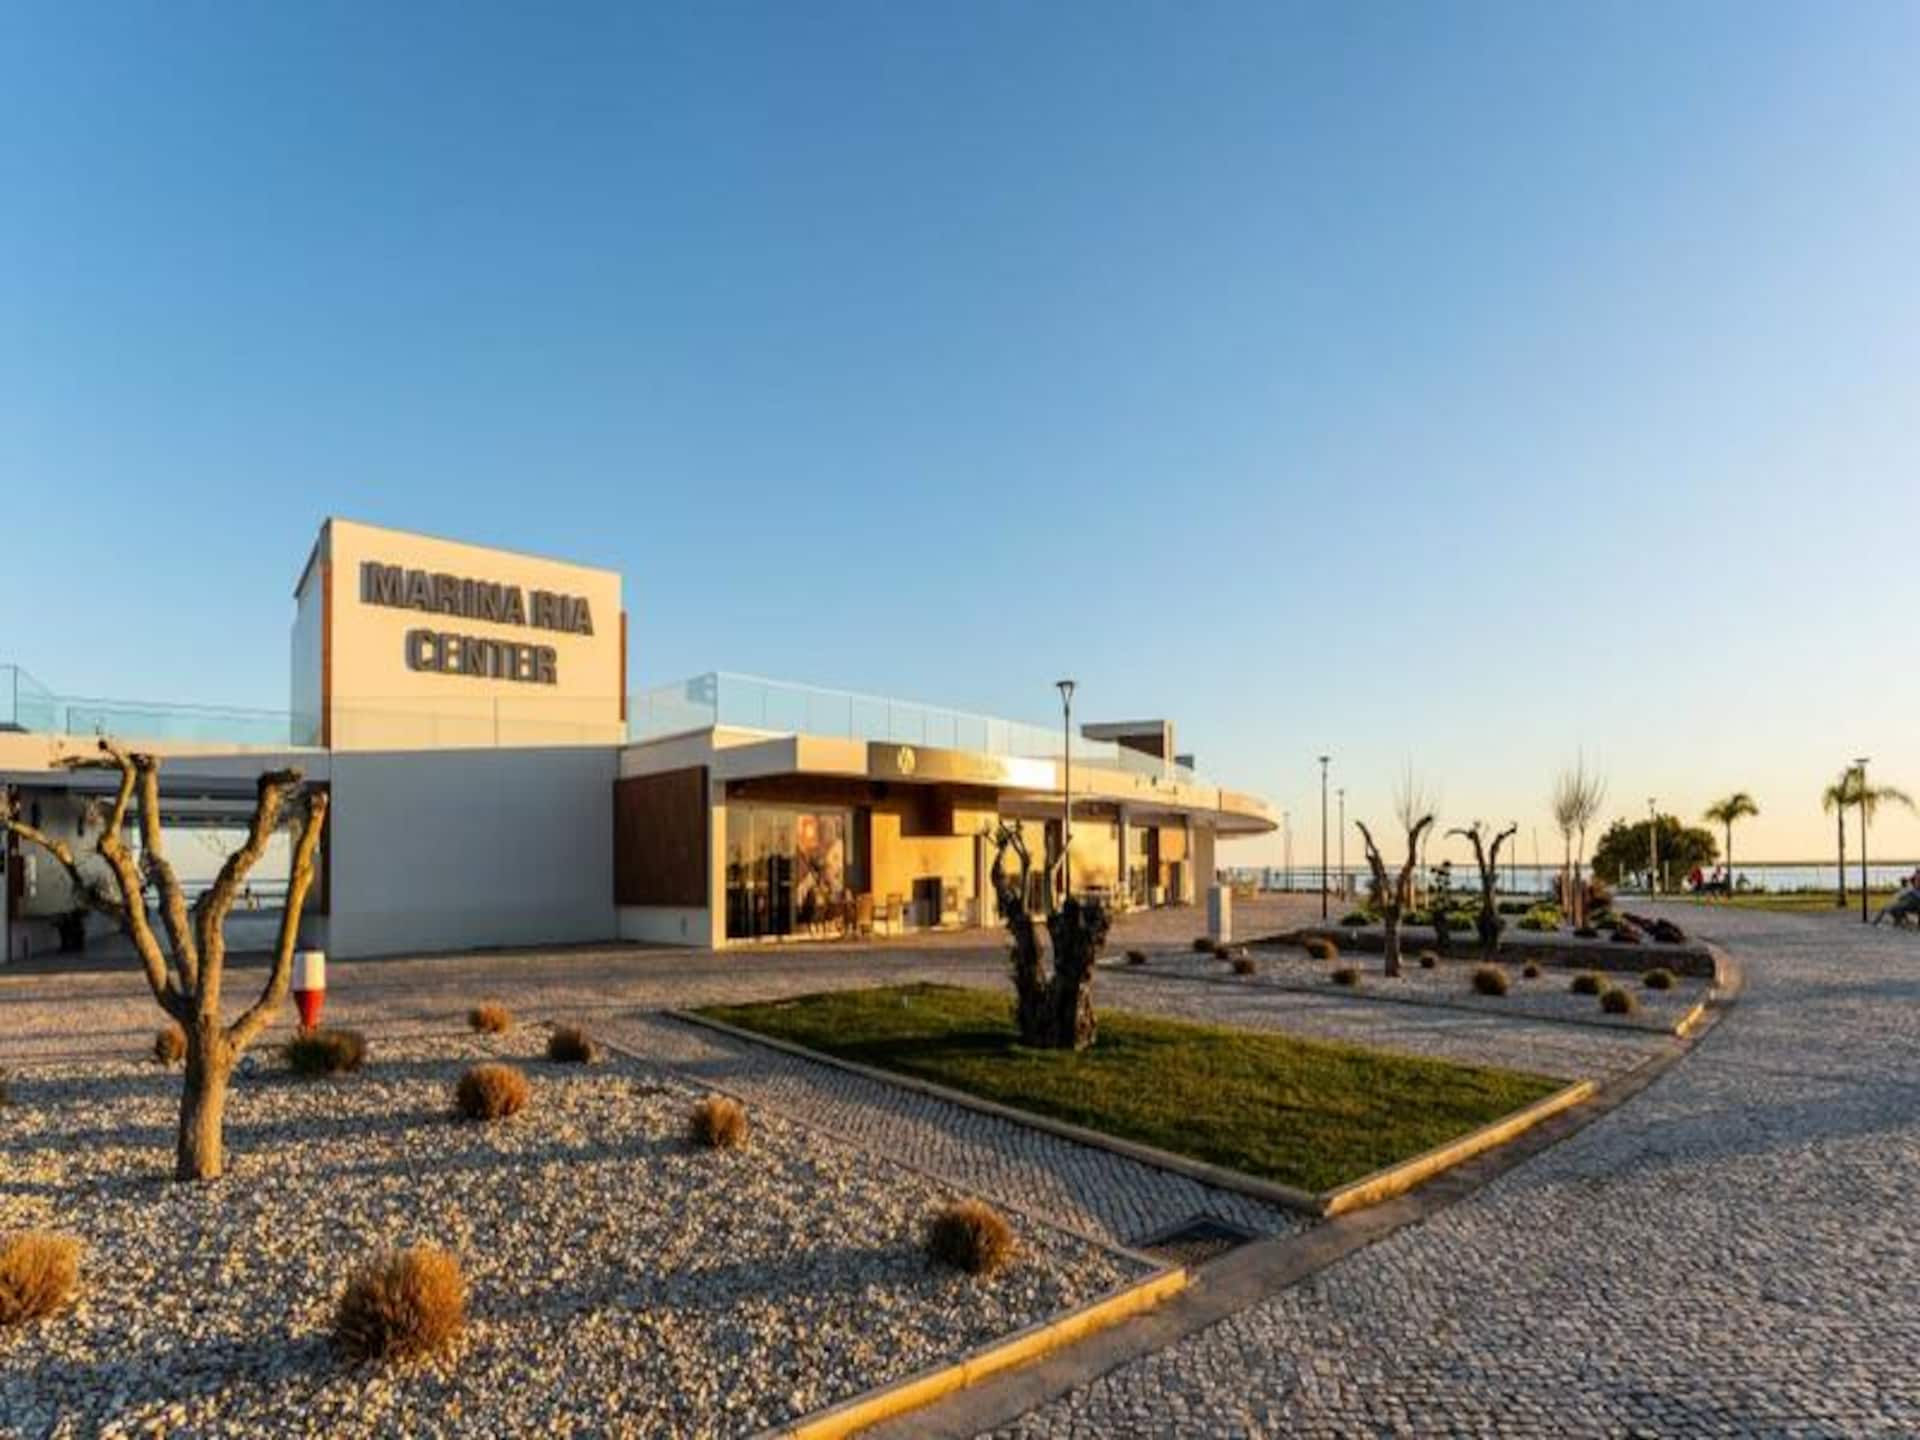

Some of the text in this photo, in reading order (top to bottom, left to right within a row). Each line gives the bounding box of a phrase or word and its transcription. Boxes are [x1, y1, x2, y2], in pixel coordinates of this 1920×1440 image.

[359, 561, 594, 635] MARINA RIA
[405, 628, 557, 684] CENTER
